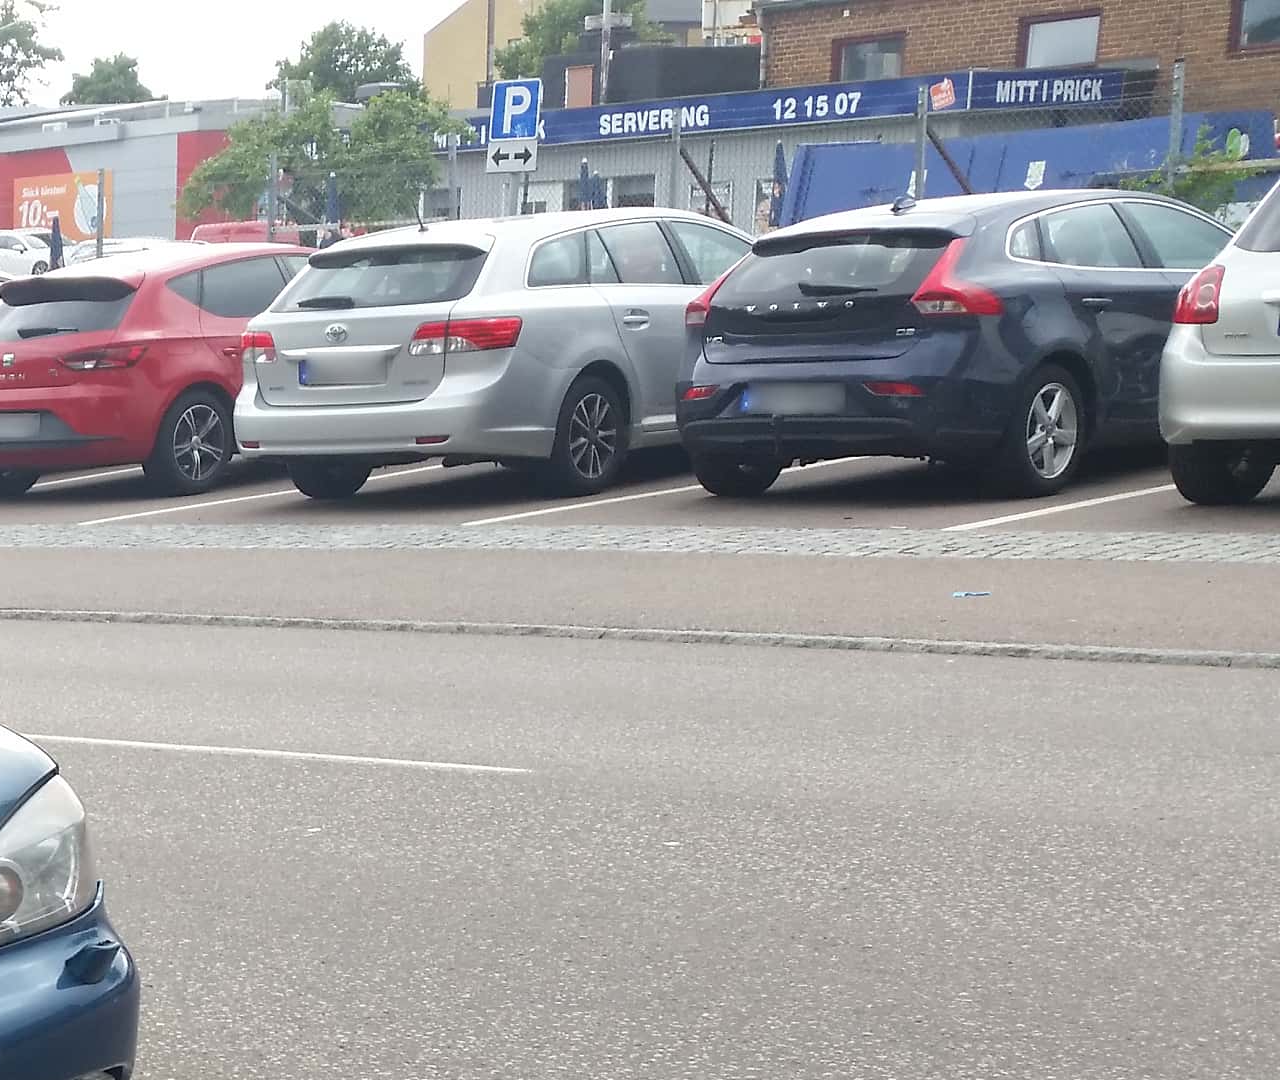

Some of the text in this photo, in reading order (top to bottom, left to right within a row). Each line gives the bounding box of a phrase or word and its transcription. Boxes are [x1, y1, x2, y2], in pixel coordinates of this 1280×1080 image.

[996, 79, 1102, 102] MITT I PRICK
[503, 86, 531, 133] P
[600, 92, 861, 135] SERVERNG 12 15 07
[746, 300, 855, 312] VOLVO
